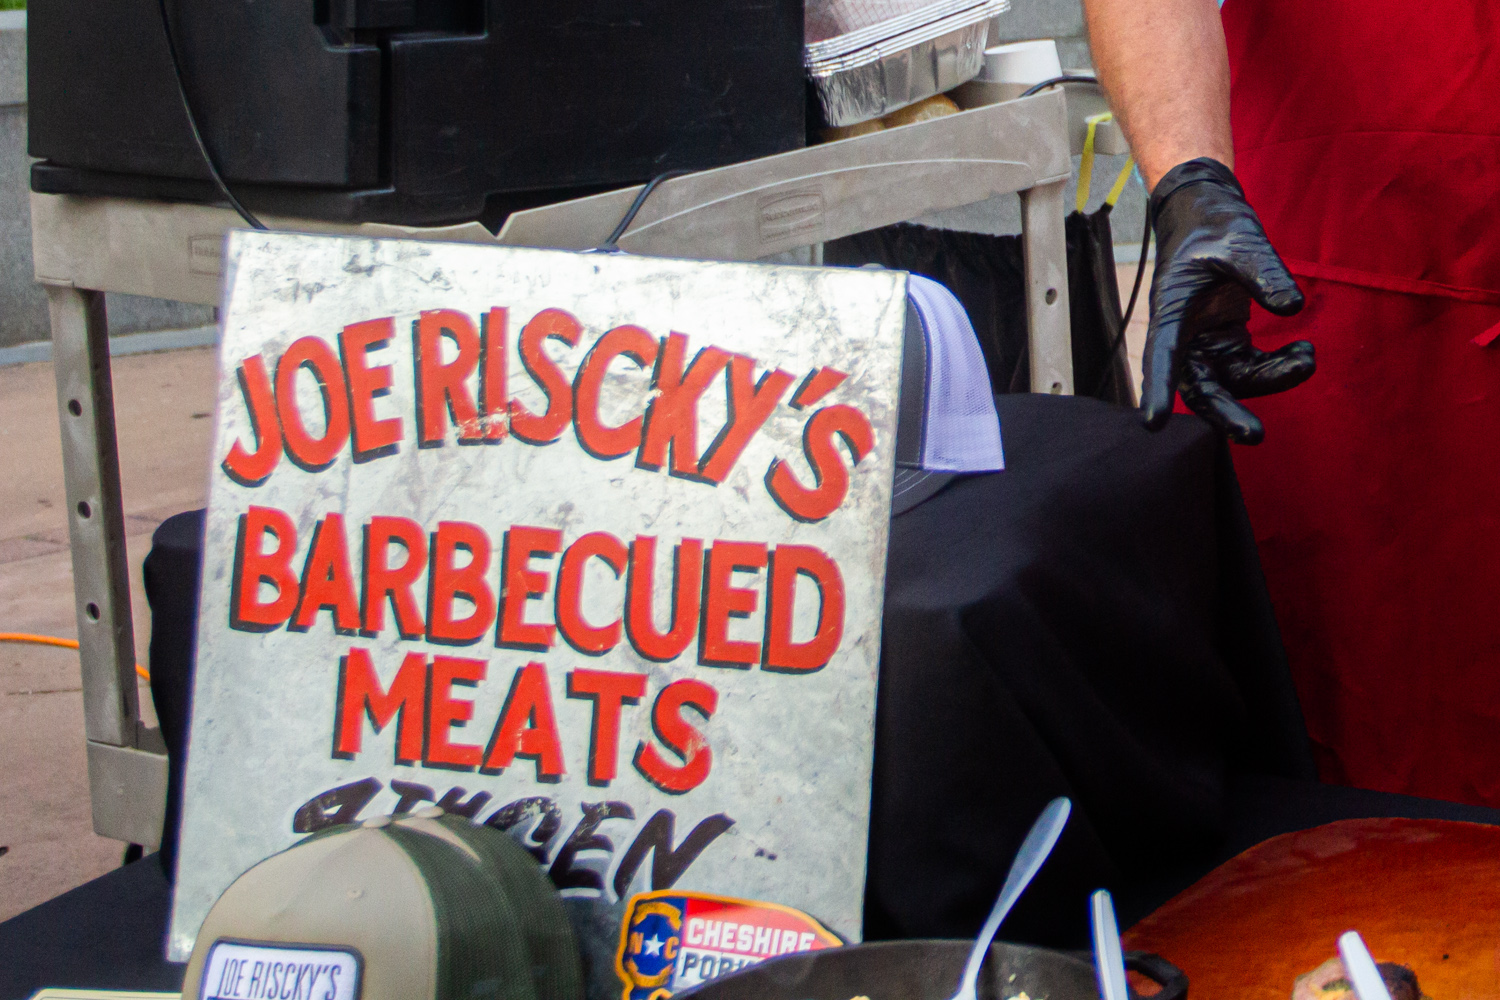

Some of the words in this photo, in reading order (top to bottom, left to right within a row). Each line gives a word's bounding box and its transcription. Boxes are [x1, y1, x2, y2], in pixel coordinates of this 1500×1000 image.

[221, 316, 404, 488] JOE
[415, 306, 876, 522] RISCKY'S
[230, 505, 846, 674] BARBECUED
[331, 648, 719, 794] MEATS
[216, 958, 249, 998] JOE
[249, 961, 342, 1000] RISCKY'S
[681, 952, 757, 979] POR
[687, 918, 815, 955] CHESHIRE
